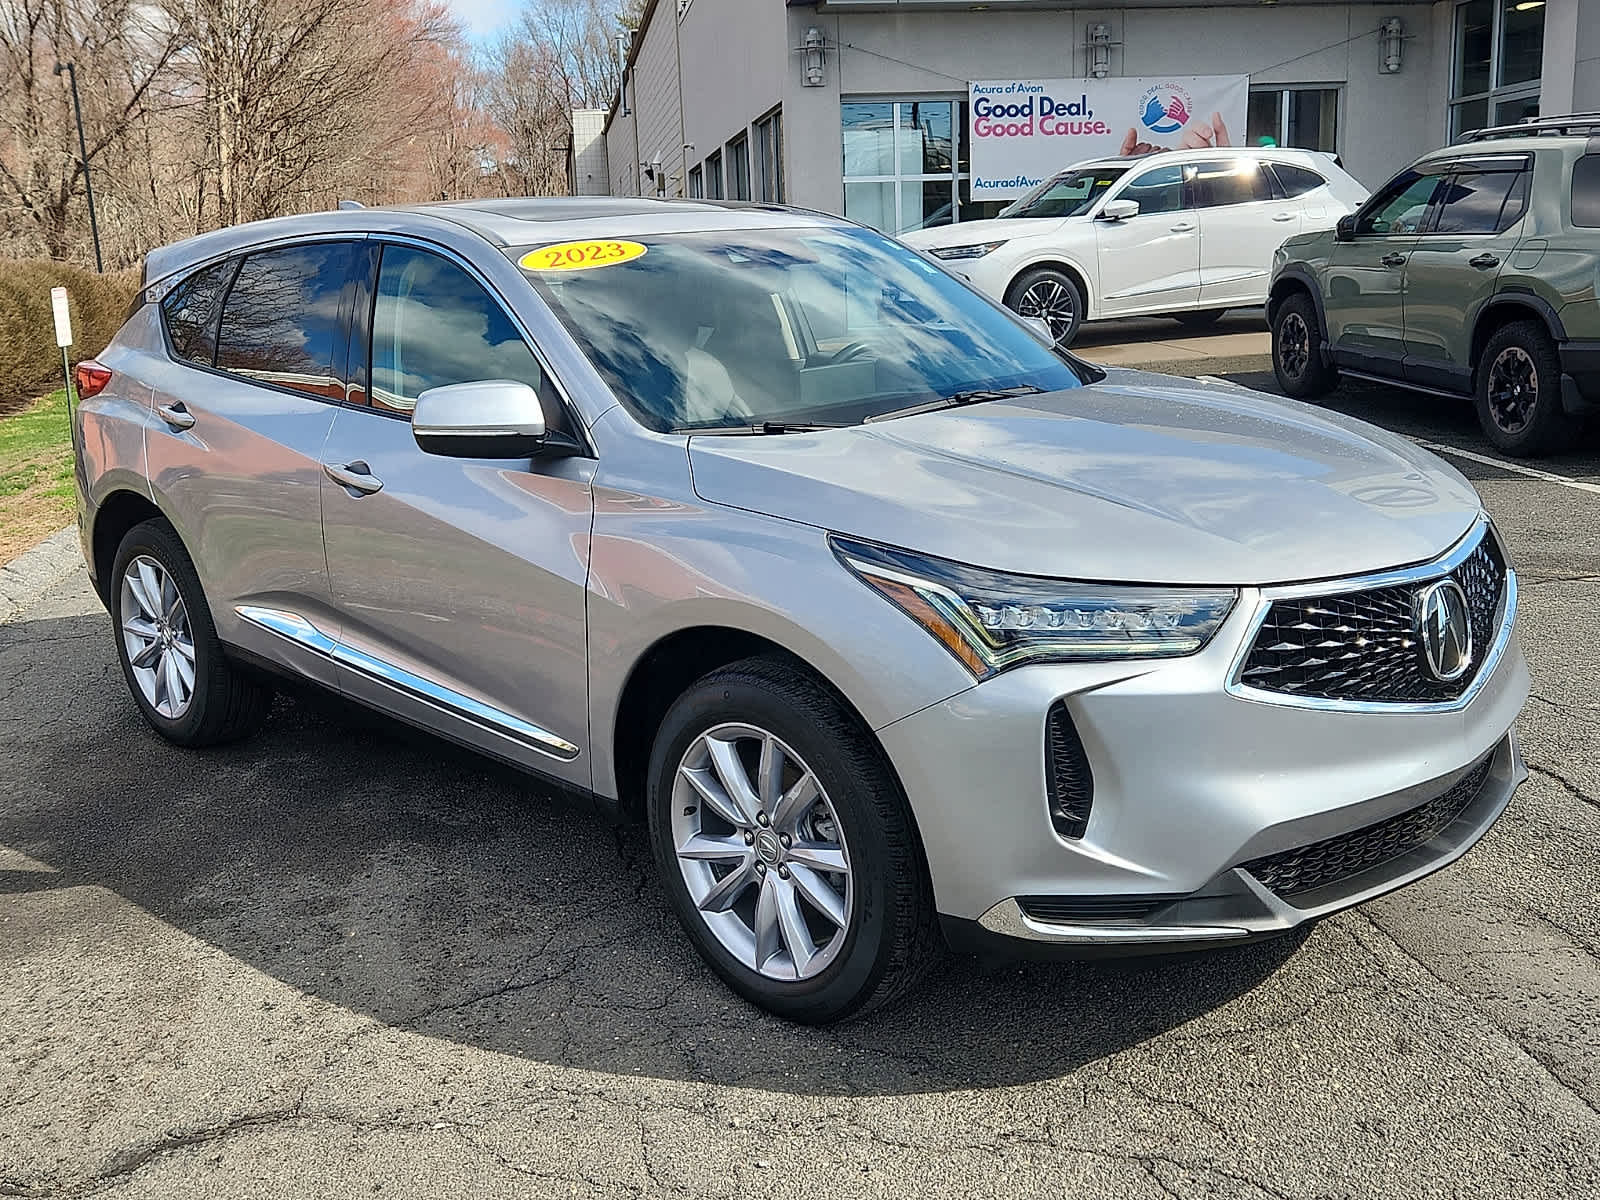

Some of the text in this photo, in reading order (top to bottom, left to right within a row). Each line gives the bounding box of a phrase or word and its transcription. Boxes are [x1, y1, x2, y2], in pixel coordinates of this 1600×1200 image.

[973, 83, 1044, 94] Acura of Avon
[974, 94, 1093, 120] Good Deal,
[974, 115, 1111, 137] Good Cause.
[545, 243, 625, 267] 2023
